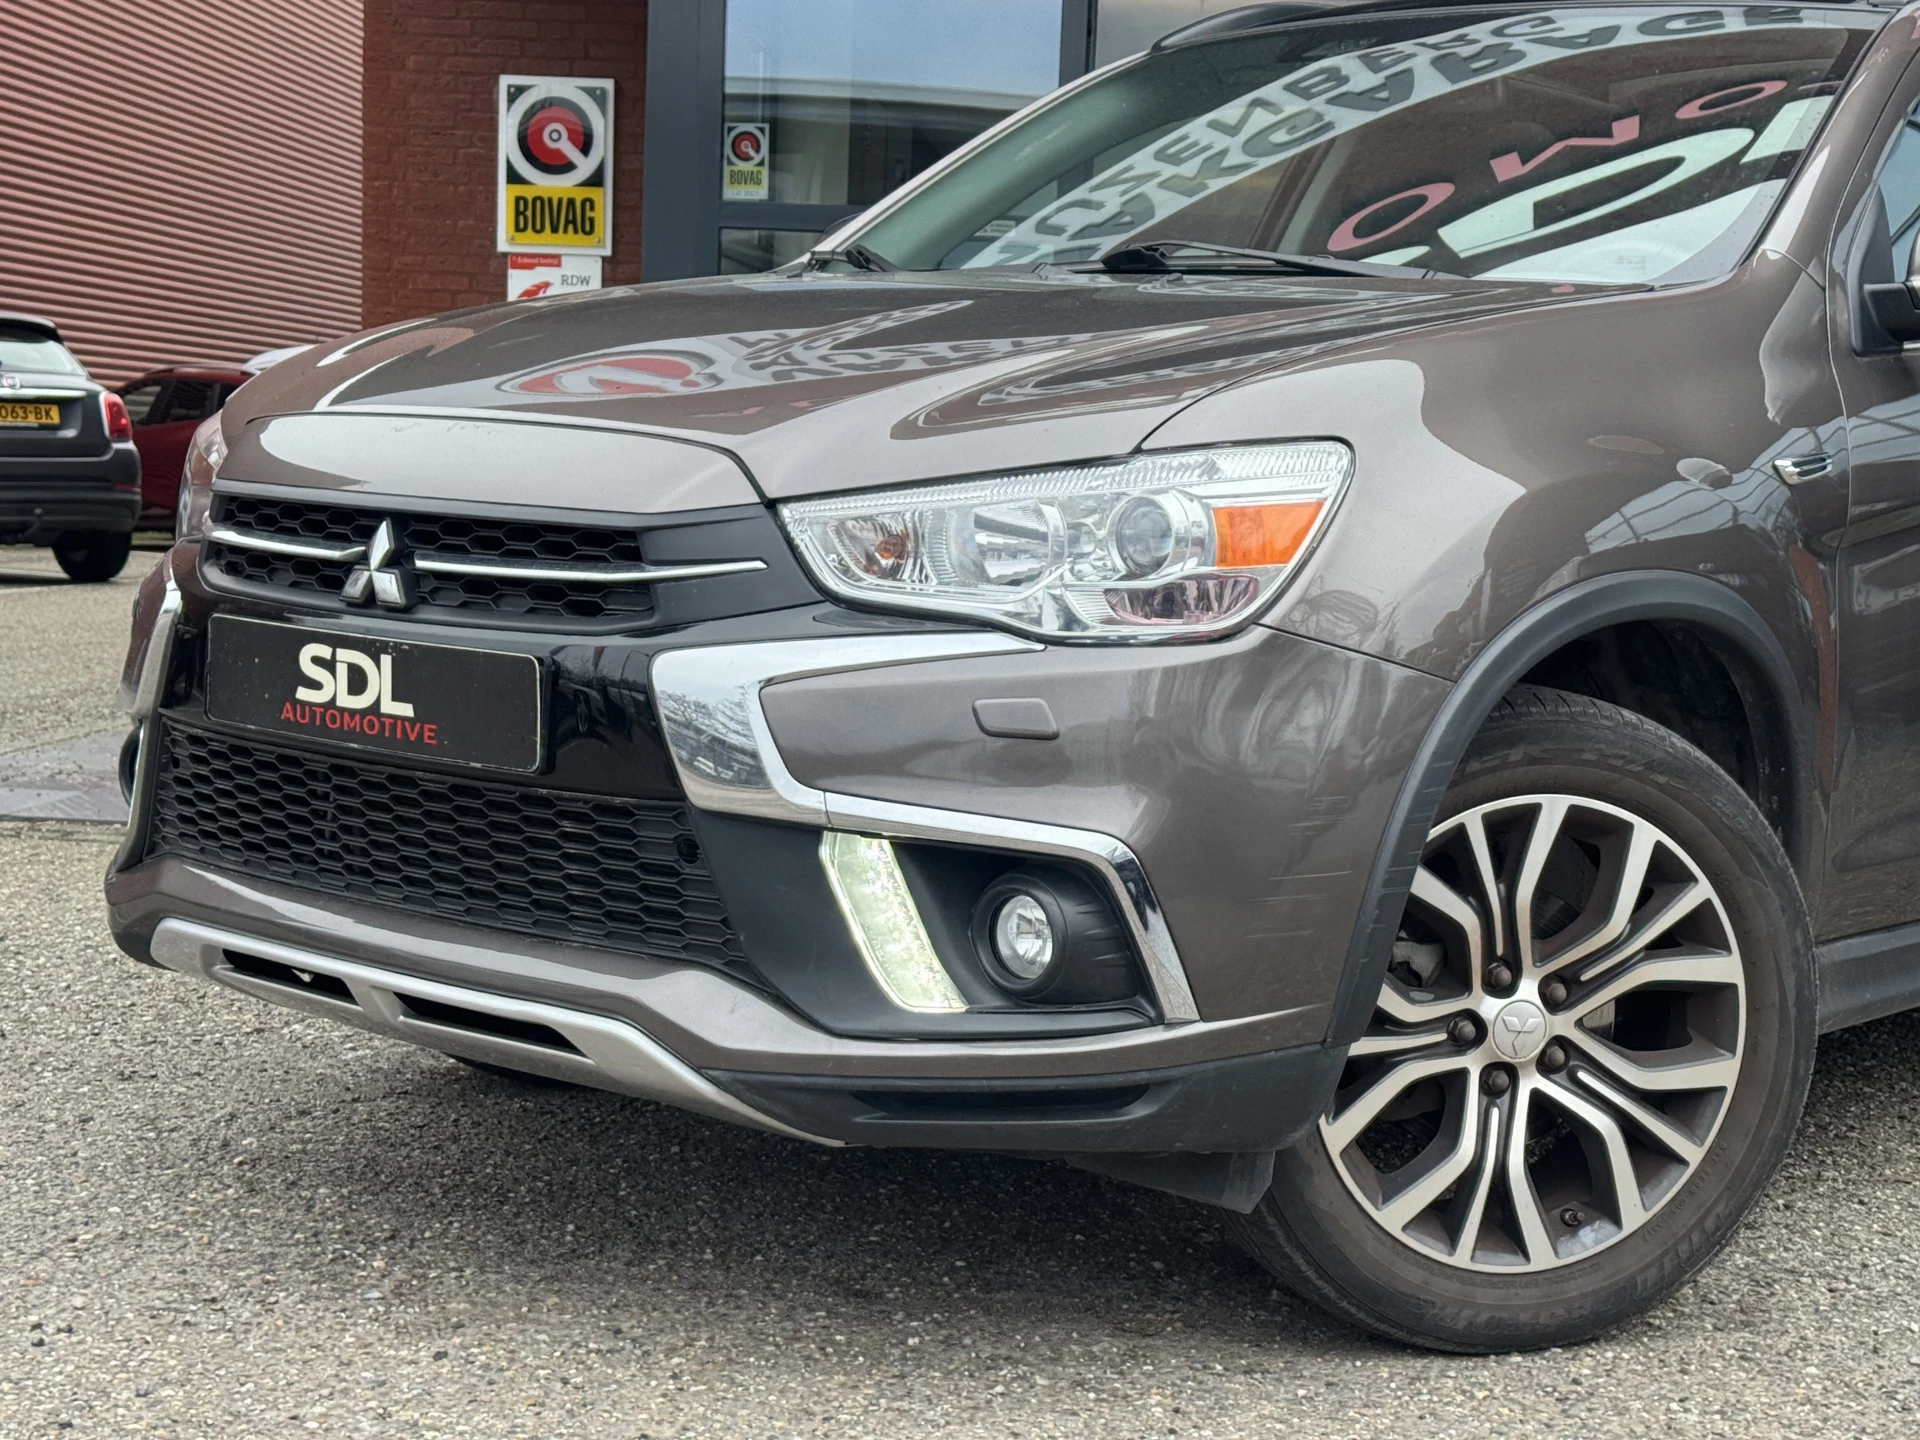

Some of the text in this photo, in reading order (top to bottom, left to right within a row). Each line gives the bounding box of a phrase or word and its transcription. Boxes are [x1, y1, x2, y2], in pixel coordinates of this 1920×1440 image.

[729, 170, 762, 185] BOVAG
[514, 195, 595, 235] BOVAG
[560, 275, 591, 286] RDW
[0, 405, 54, 420] 063-BK
[295, 643, 414, 717] SDL
[280, 702, 438, 745] AUTOMOTIVE
